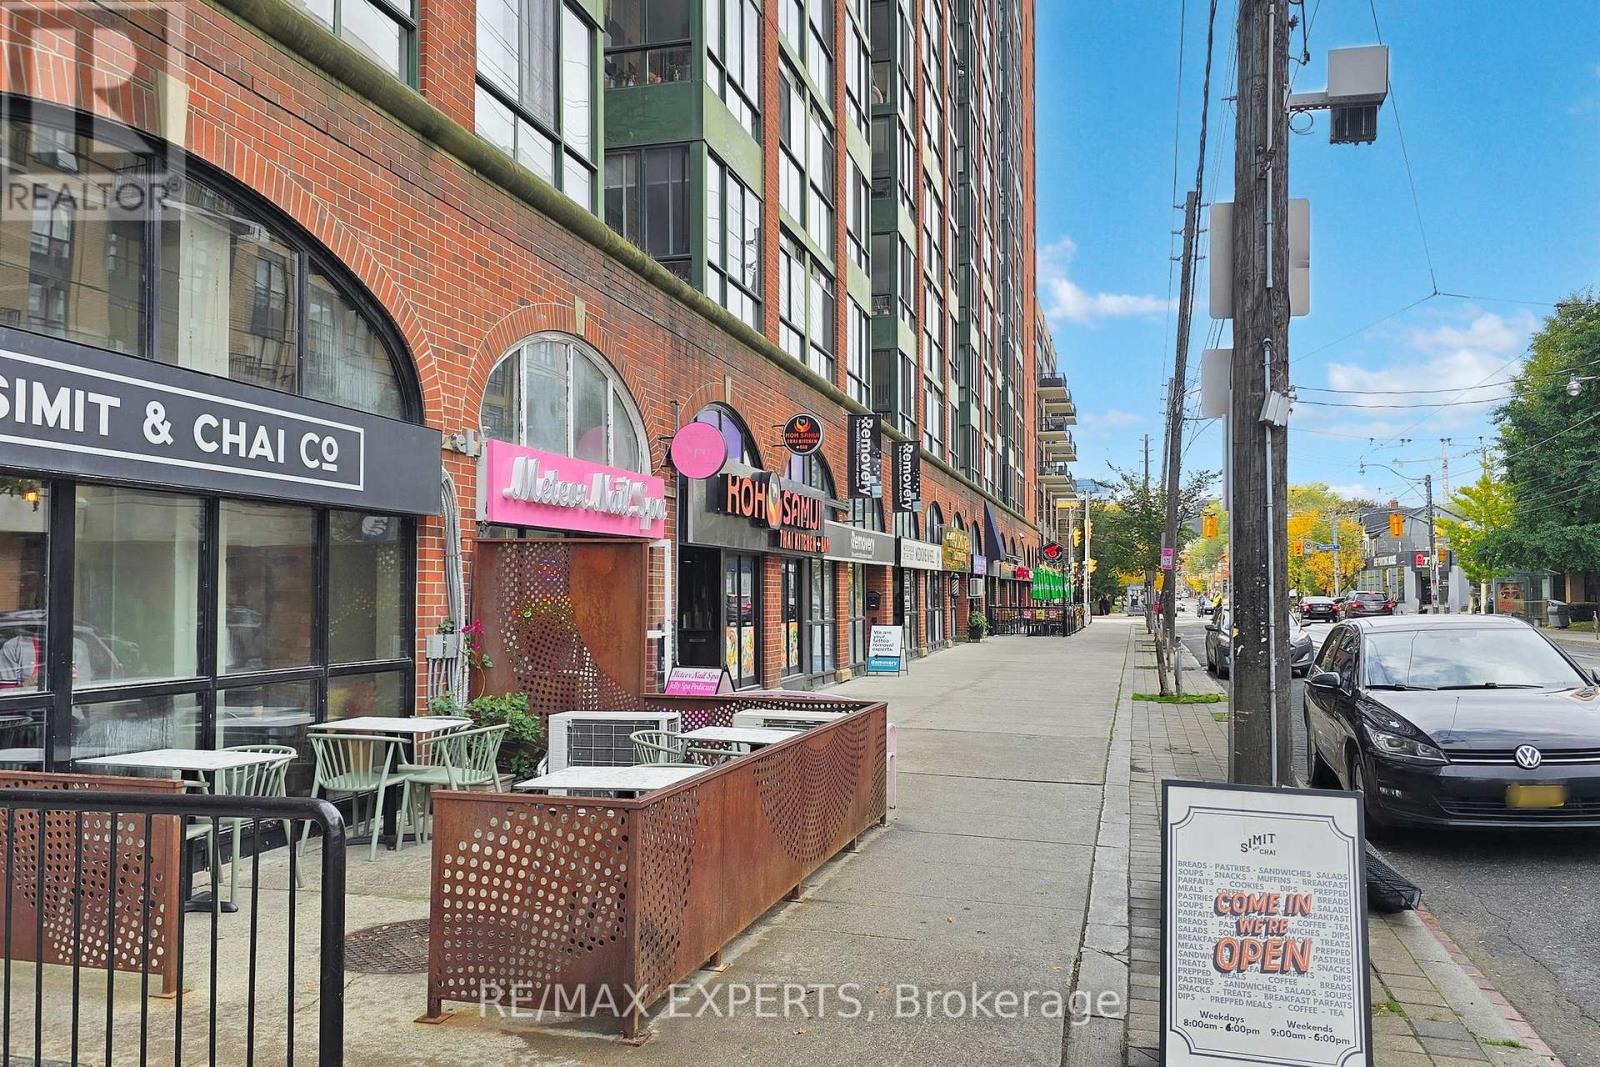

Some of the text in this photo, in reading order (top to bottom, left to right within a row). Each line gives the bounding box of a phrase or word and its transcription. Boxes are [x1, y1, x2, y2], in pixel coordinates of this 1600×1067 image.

[143, 400, 174, 446] &
[193, 413, 285, 464] CHAI
[859, 416, 874, 496] Removery
[901, 443, 914, 510] Removery
[727, 474, 765, 519] KOH
[783, 489, 821, 530] SAMUI
[780, 529, 794, 550] THAI
[1240, 834, 1275, 853] SIMIT
[1178, 861, 1348, 880] BREADS PASTRIES SANDWICHES SALADS
[1214, 872, 1246, 880] SNACKS
[1257, 875, 1291, 884] MUFFINS
[1302, 879, 1348, 889] BREAKFAST
[1178, 877, 1214, 885] PARFAITS
[1229, 881, 1264, 890] COOKIES
[1314, 888, 1348, 897] PREPPED
[1178, 885, 1349, 906] MEALS BREADS
[1178, 893, 1349, 914] PASTRIES SALADS
[1178, 901, 1203, 909] SOUPS
[1214, 892, 1312, 916] COME IN
[1178, 909, 1214, 919] PARFAITS
[1297, 920, 1327, 929] COFFEE
[1178, 917, 1208, 926] BREADS
[1236, 919, 1288, 936] WE'RE
[1178, 926, 1208, 934] SALADS
[1321, 939, 1350, 948] TREATS
[1178, 942, 1350, 965] MEALS PASTRIES
[1213, 937, 1313, 973] OPEN
[1316, 947, 1350, 956] PREPPED
[1178, 959, 1207, 968] TREATS
[1317, 964, 1351, 974] SNACKS
[1178, 967, 1211, 976] PREPPED
[1268, 977, 1297, 985] COFFEE
[1320, 982, 1352, 991] BREADS
[1178, 975, 1352, 1000] PASTRIES SANDWICHES SALADS SOUPS
[1178, 984, 1352, 1009] SNACKS TREATS BREAKFAST PARFAITS
[1210, 996, 1244, 1005] PREPPED
[1246, 1000, 1272, 1008] MEALS
[1288, 1004, 1317, 1014] COFFEE
[1183, 1019, 1217, 1030] 8:00am
[1200, 1010, 1244, 1024] Weekdays
[1287, 1020, 1333, 1033] Weekends
[1271, 1028, 1306, 1040] 9:00am
